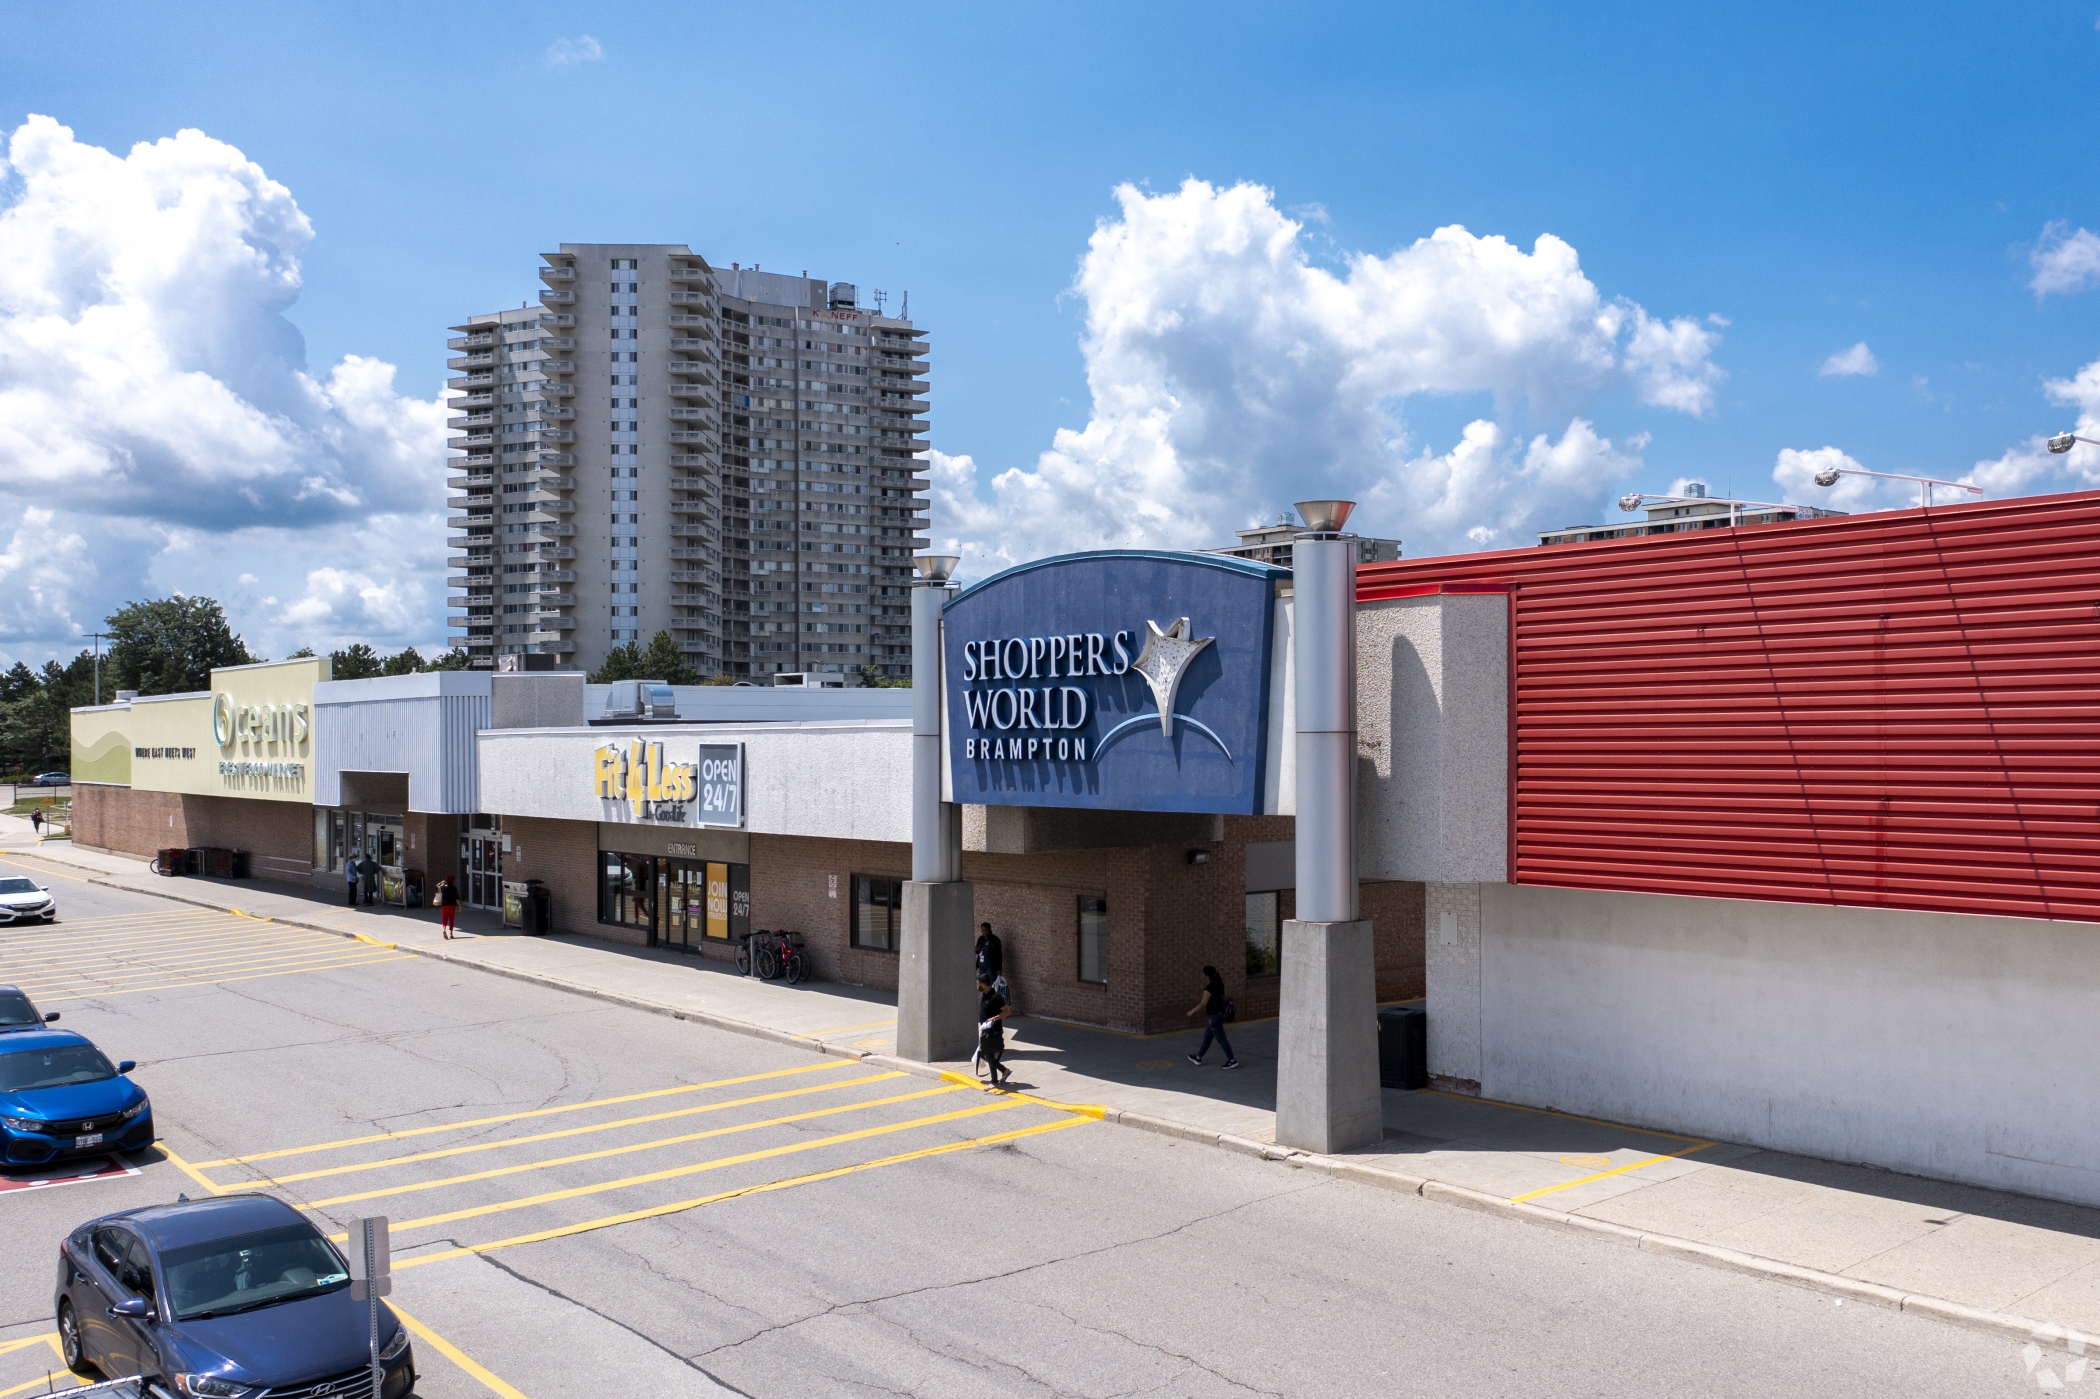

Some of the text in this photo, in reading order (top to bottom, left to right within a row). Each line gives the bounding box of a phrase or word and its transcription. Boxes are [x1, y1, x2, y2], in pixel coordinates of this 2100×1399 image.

[964, 630, 1130, 681] SHOPPERS
[963, 686, 1087, 729] WORLD
[214, 693, 308, 747] Oceans
[966, 738, 1086, 760] BRAMPTON
[219, 761, 304, 778] FRESH FOOD MARKET
[703, 759, 737, 781] OPEN
[703, 783, 737, 812] 24/7
[668, 842, 696, 855] ENTRANCE
[708, 880, 727, 897] JOIN
[734, 890, 749, 902] OPEN
[708, 897, 727, 913] NOW
[734, 902, 749, 917] 24/7
